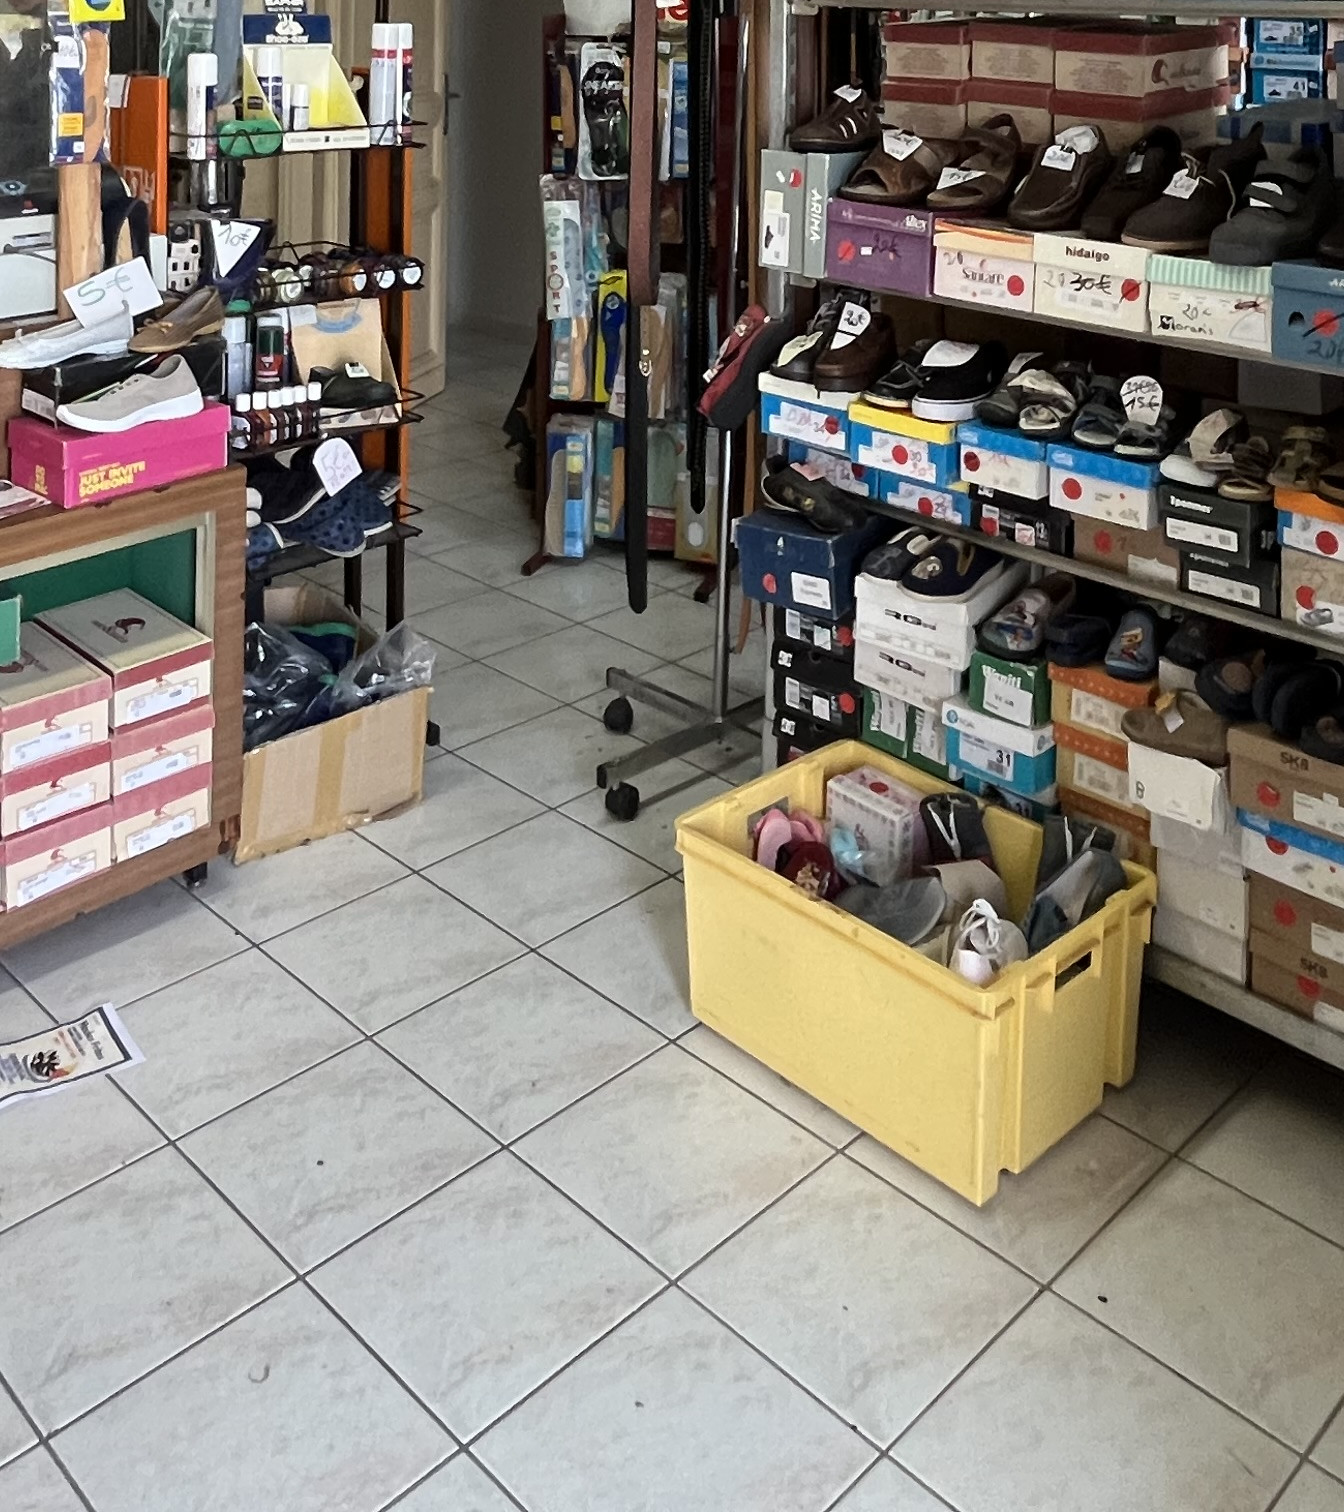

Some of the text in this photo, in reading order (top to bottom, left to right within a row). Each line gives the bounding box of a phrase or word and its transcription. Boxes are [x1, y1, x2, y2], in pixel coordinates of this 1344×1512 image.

[810, 187, 824, 244] ARIMA
[1065, 245, 1110, 262] hidalgo
[995, 749, 1011, 768] 31
